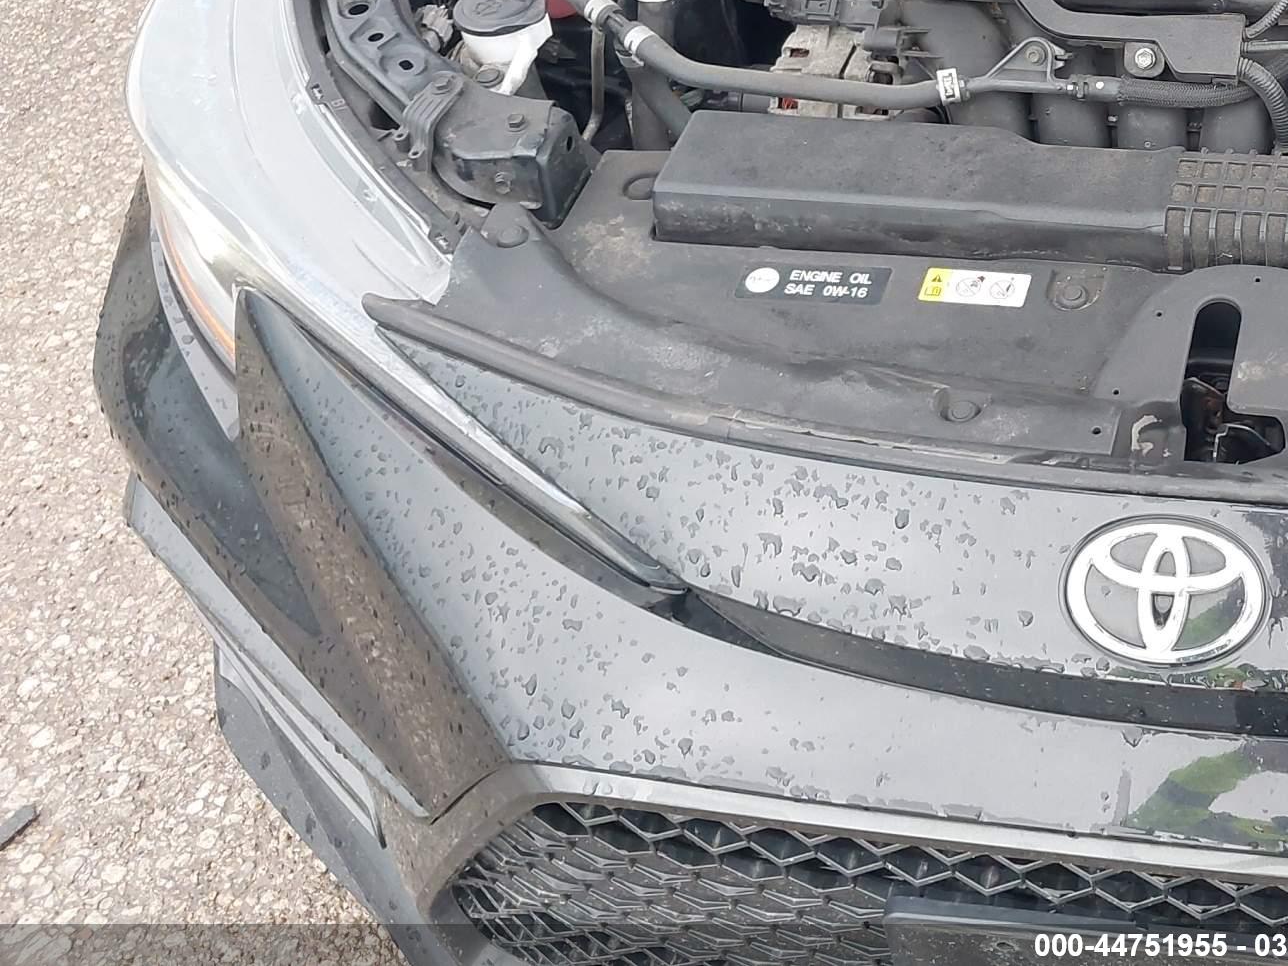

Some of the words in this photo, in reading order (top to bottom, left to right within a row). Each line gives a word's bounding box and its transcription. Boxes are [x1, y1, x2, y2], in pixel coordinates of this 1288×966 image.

[790, 270, 842, 283] ENGINE
[850, 274, 872, 285] OIL
[784, 283, 815, 295] SAE
[824, 285, 868, 298] 0W-16
